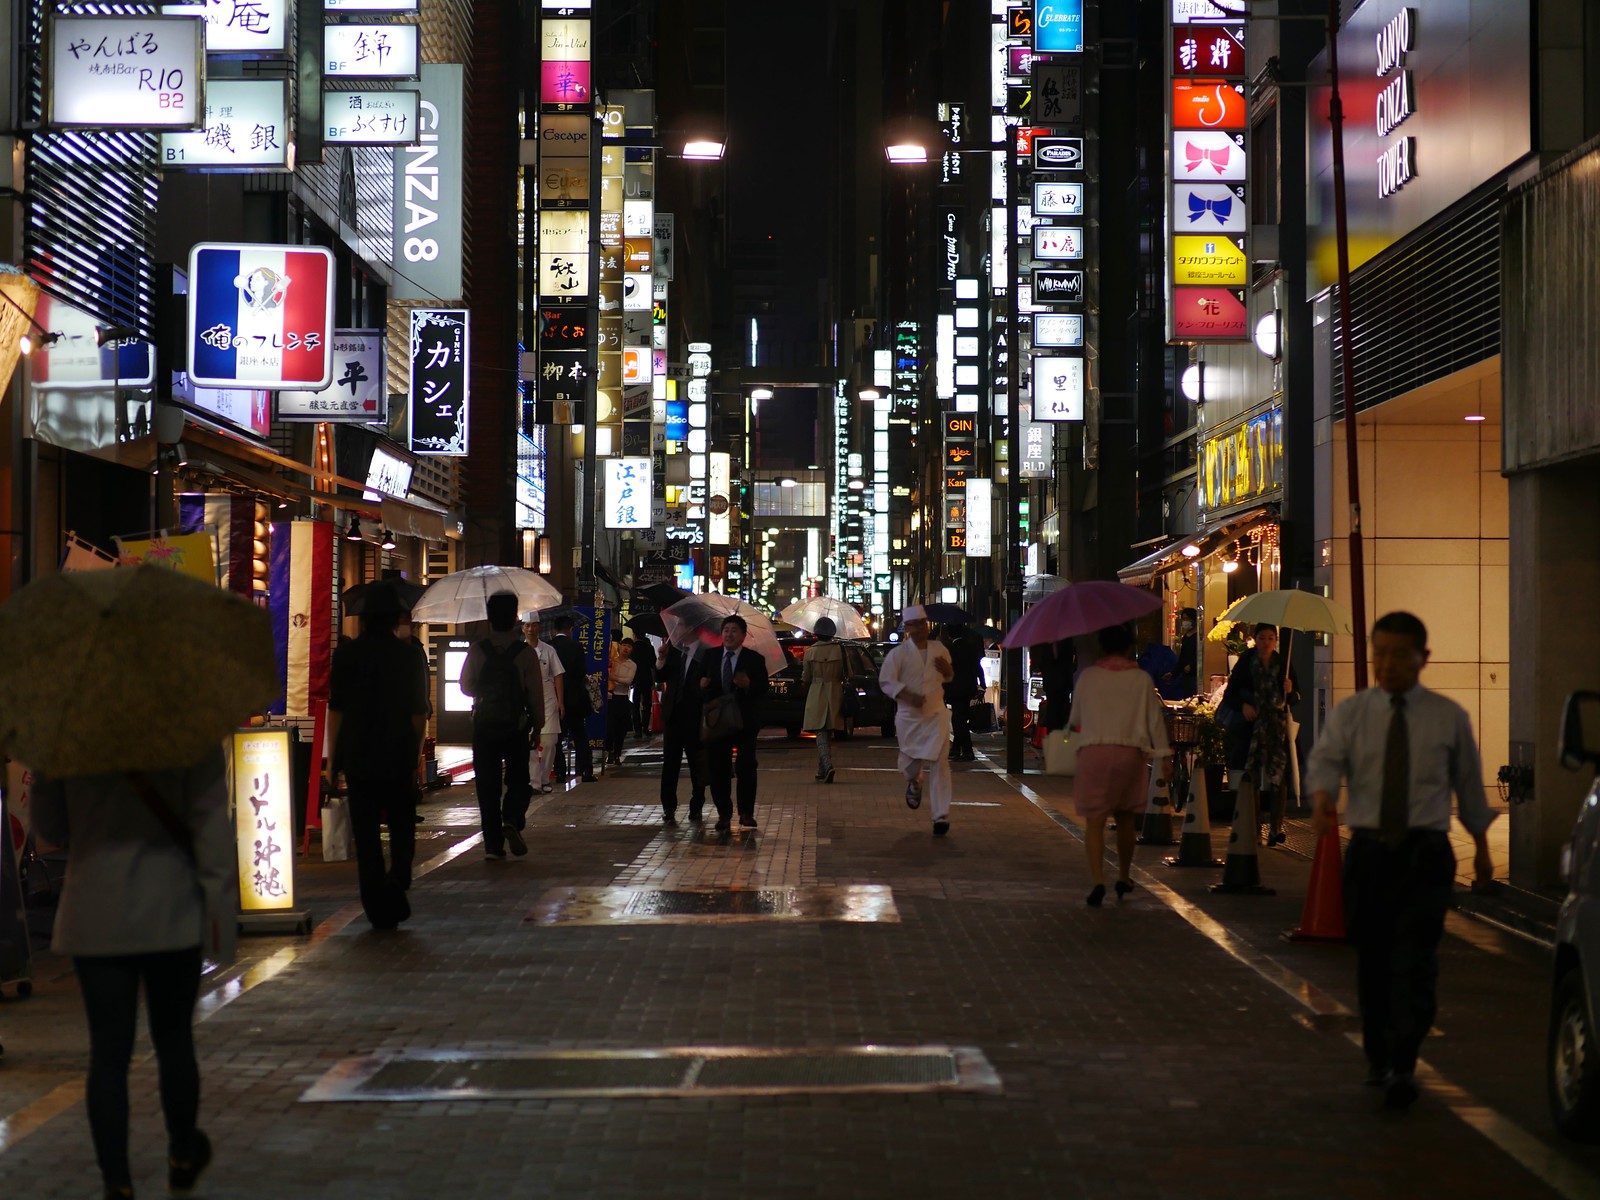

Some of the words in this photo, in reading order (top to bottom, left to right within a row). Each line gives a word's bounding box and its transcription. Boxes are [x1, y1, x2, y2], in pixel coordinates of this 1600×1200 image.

[1038, 6, 1080, 28] CELEBRATE
[1235, 30, 1244, 41] 4
[1376, 7, 1409, 77] SANYO
[67, 33, 159, 59] やんばる
[353, 30, 391, 68] 錦
[88, 64, 137, 75] 焼酎Bar
[329, 61, 346, 71] BF
[138, 69, 184, 91] R10
[553, 72, 579, 98] 華
[158, 92, 184, 109] B2
[349, 96, 362, 109] 酒
[1376, 70, 1411, 137] GINZA
[329, 127, 346, 137] BF
[352, 113, 407, 135] ふくすけ
[203, 122, 281, 154] 磯銀
[543, 128, 587, 143] Escape
[1236, 135, 1245, 146] 3
[166, 149, 185, 161] B1
[1376, 135, 1411, 200] TOWER
[1041, 190, 1077, 207] 藤田
[1236, 186, 1245, 197] 3
[403, 237, 439, 263] 8
[1237, 238, 1244, 250] 1
[1178, 256, 1243, 265] タチカワブラインド
[550, 257, 579, 290] 秋山
[1188, 271, 1235, 279] 銀座ショールーム
[557, 296, 572, 304] 1F
[1238, 290, 1244, 302] 1
[545, 310, 561, 319] Bar
[1203, 299, 1220, 315] 花
[1176, 321, 1246, 329] ケン・フローリスト
[201, 323, 321, 351] 俺のフレンチ
[239, 355, 279, 367] 銀座本店
[422, 341, 453, 418] カシェ
[542, 361, 587, 382] 柳本
[556, 392, 570, 400] B1
[309, 400, 359, 411] 醸造元直営
[949, 419, 972, 432] GIN
[1027, 427, 1042, 459] 銀座
[1023, 461, 1045, 472] BLD
[616, 461, 638, 525] 江戸銀
[593, 608, 605, 661] 歩きたばこ
[250, 772, 288, 897] リトル沖縄
